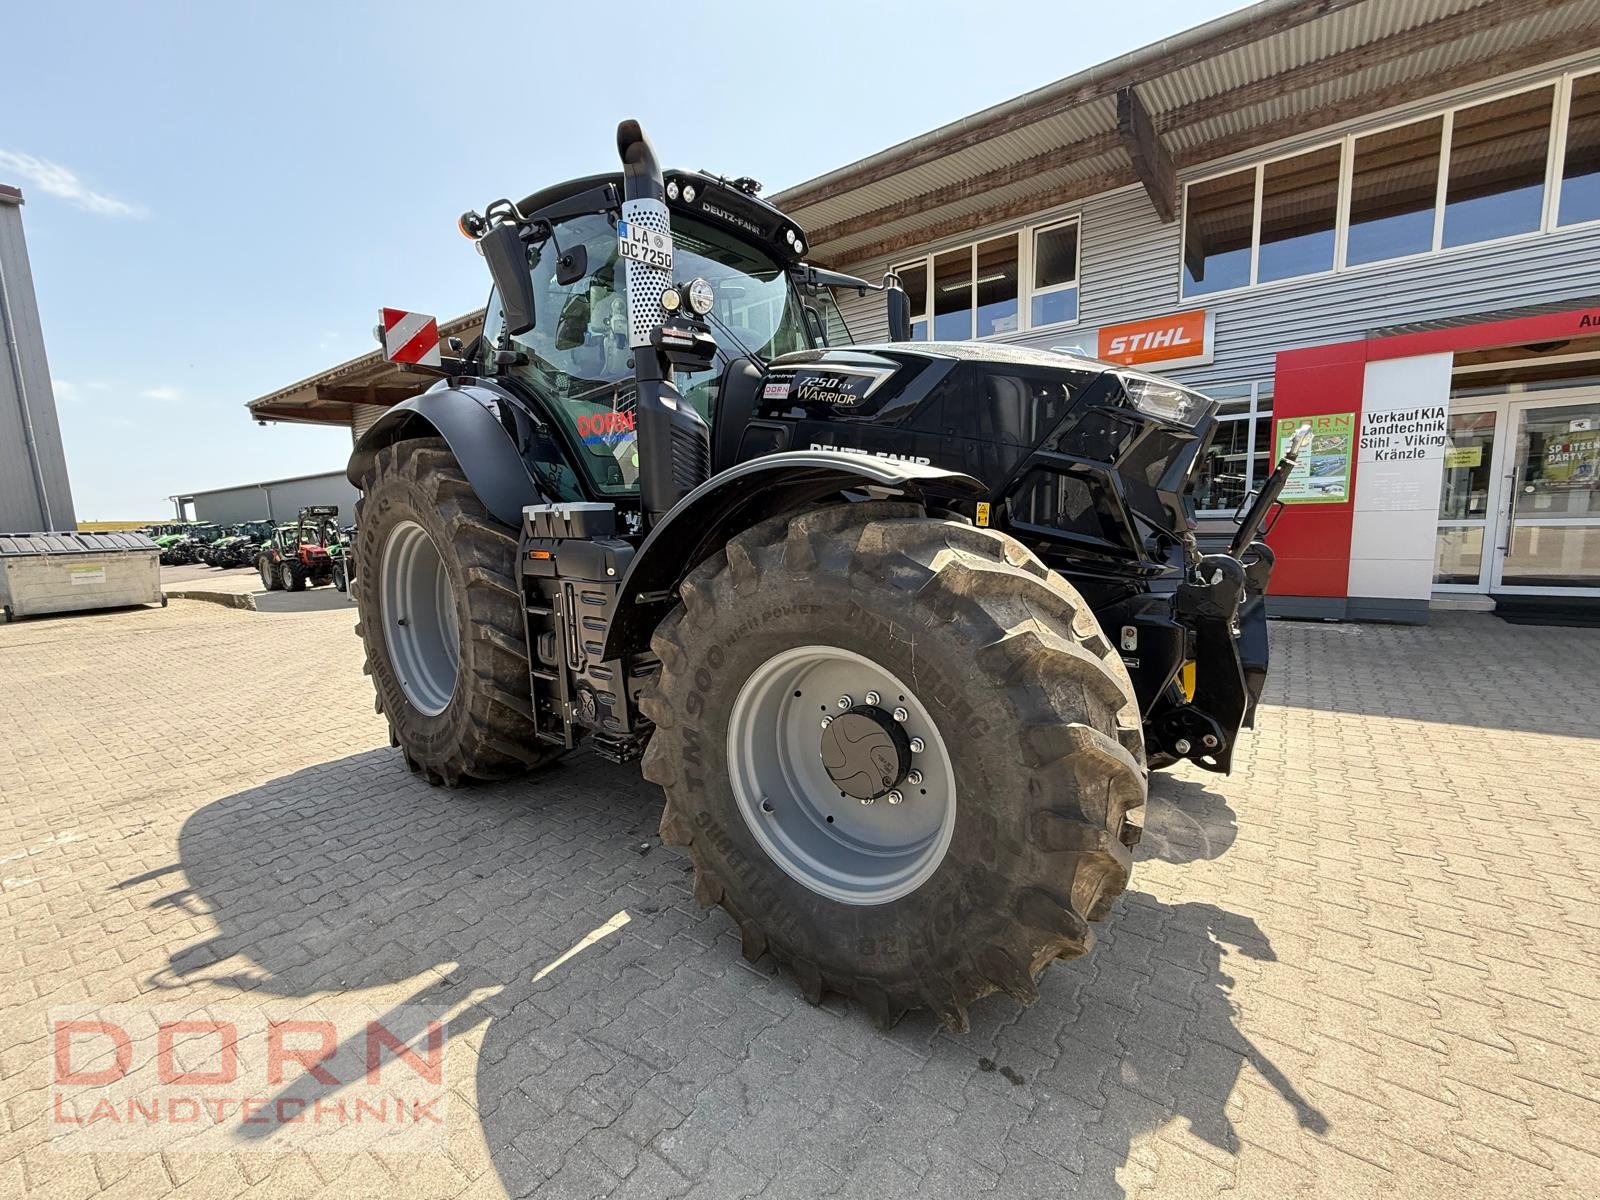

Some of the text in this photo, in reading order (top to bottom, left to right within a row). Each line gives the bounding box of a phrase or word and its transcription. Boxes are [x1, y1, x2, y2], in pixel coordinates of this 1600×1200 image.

[632, 226, 649, 246] LA
[621, 240, 672, 268] DC 7250
[1108, 327, 1192, 356] STIHL
[800, 377, 839, 388] 7250
[797, 385, 856, 405] WARRIOR
[577, 410, 634, 437] DORN
[1367, 407, 1445, 424] Verkauf KIA
[1362, 419, 1445, 436] Landtechnik
[1360, 437, 1390, 449] Stihl
[1404, 434, 1446, 447] Viking
[1375, 447, 1426, 461] Kränzle
[1548, 452, 1583, 462] PARTY
